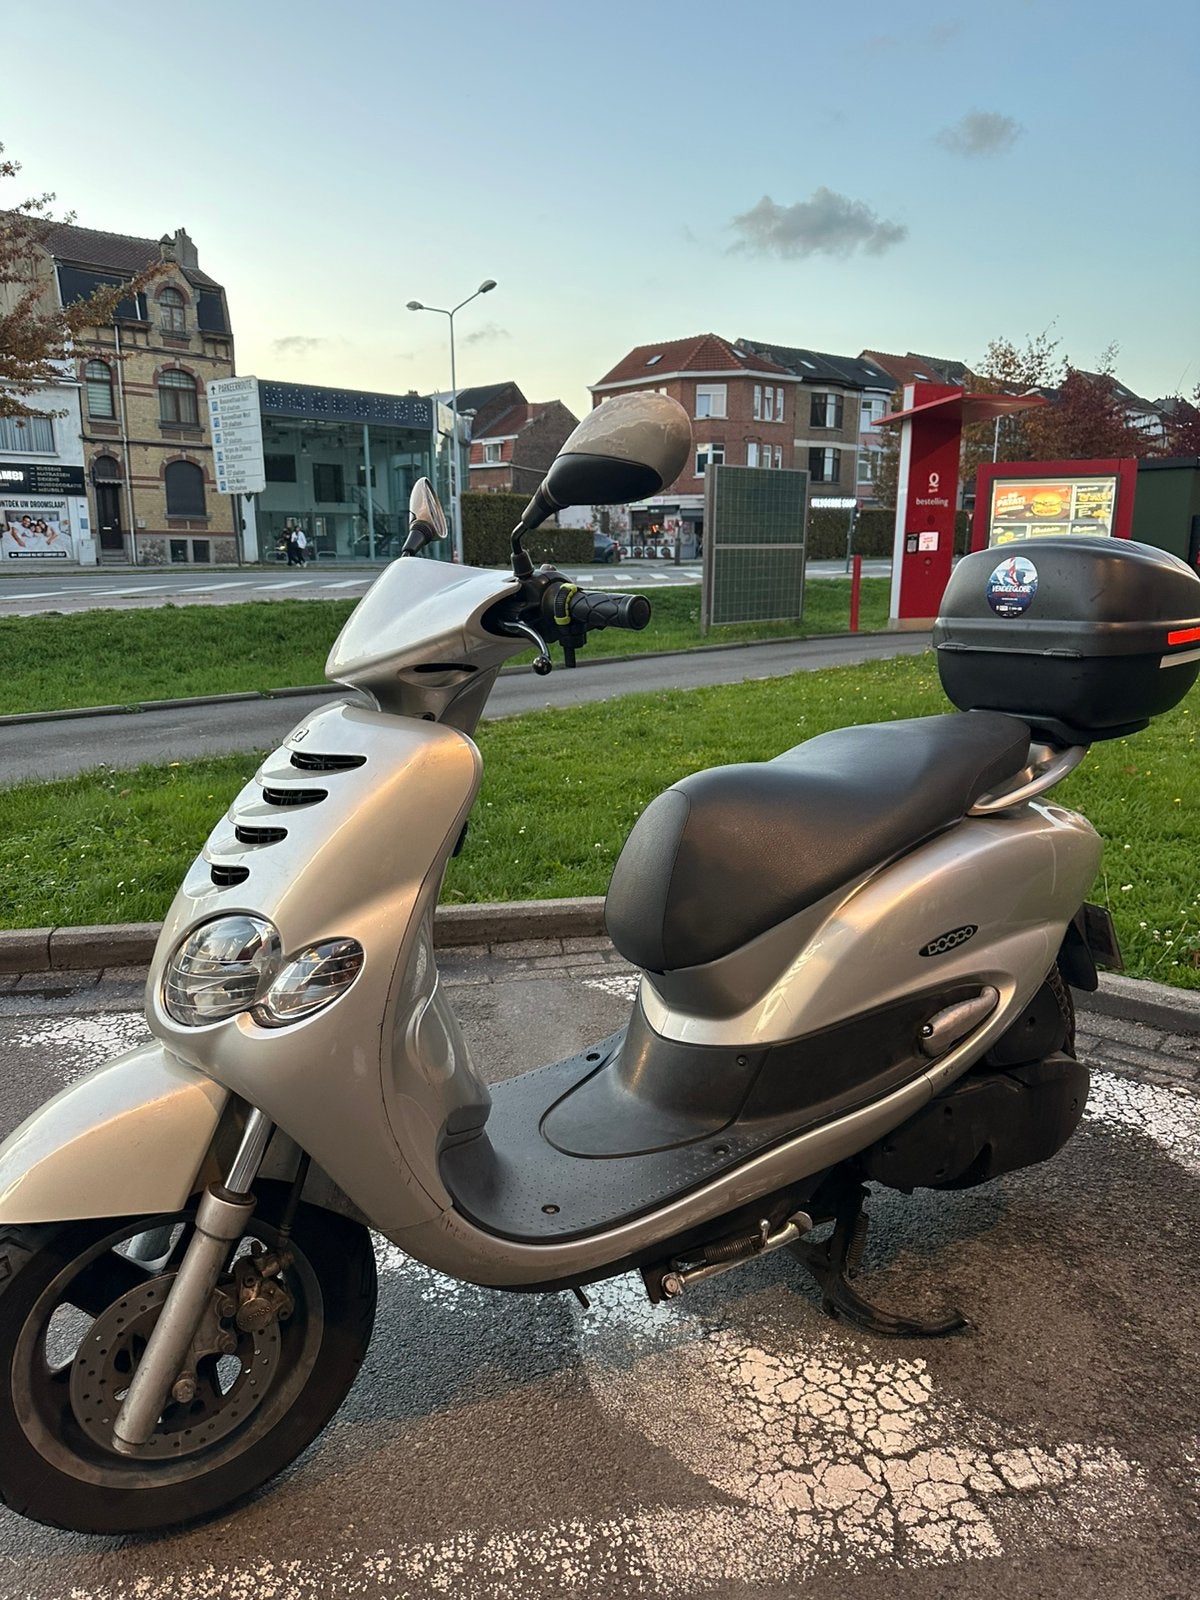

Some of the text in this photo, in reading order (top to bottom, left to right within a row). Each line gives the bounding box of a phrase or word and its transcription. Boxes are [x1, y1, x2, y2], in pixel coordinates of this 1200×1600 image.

[20, 500, 30, 508] UW
[30, 500, 67, 509] DROOMSLAAP!
[916, 497, 949, 508] bestelling
